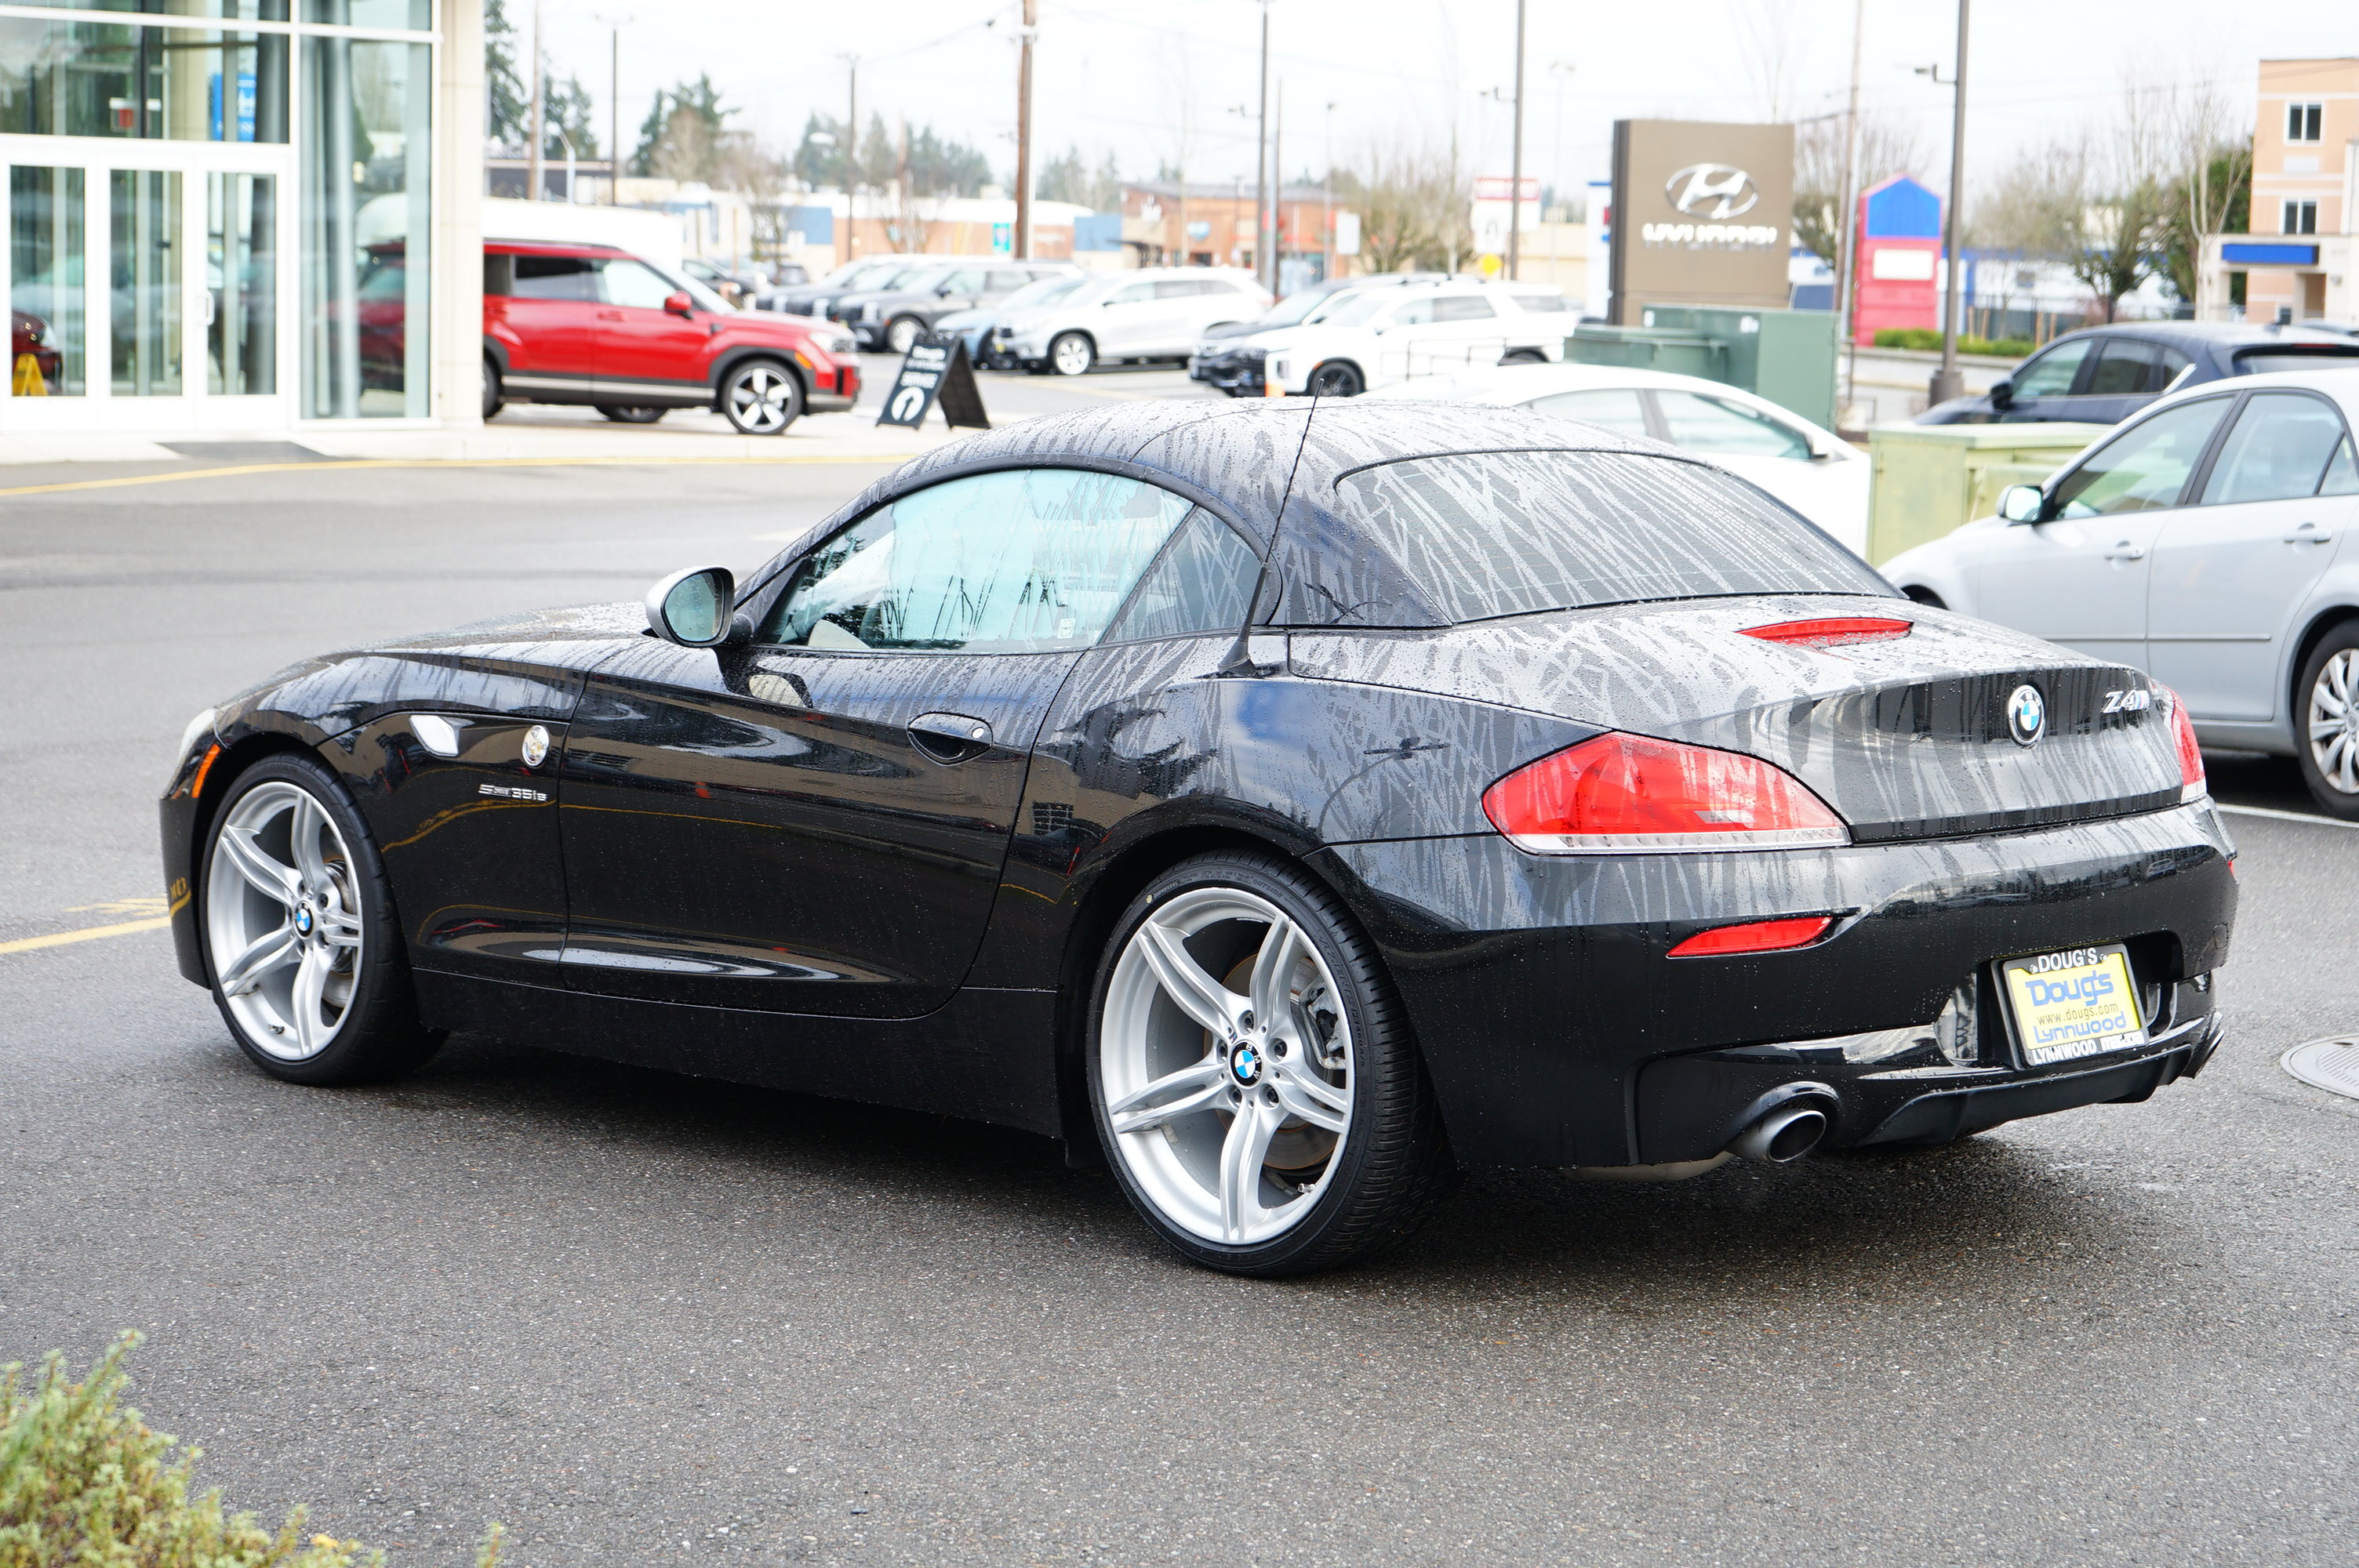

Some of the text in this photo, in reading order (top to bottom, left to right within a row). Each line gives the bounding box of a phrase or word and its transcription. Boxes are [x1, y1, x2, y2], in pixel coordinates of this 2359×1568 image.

[2037, 947, 2099, 974] DOUG'S
[2037, 1002, 2119, 1025] www.dougs.com
[2033, 1011, 2127, 1044] Lynnwood
[2031, 1040, 2097, 1065] LYNNWOOD
